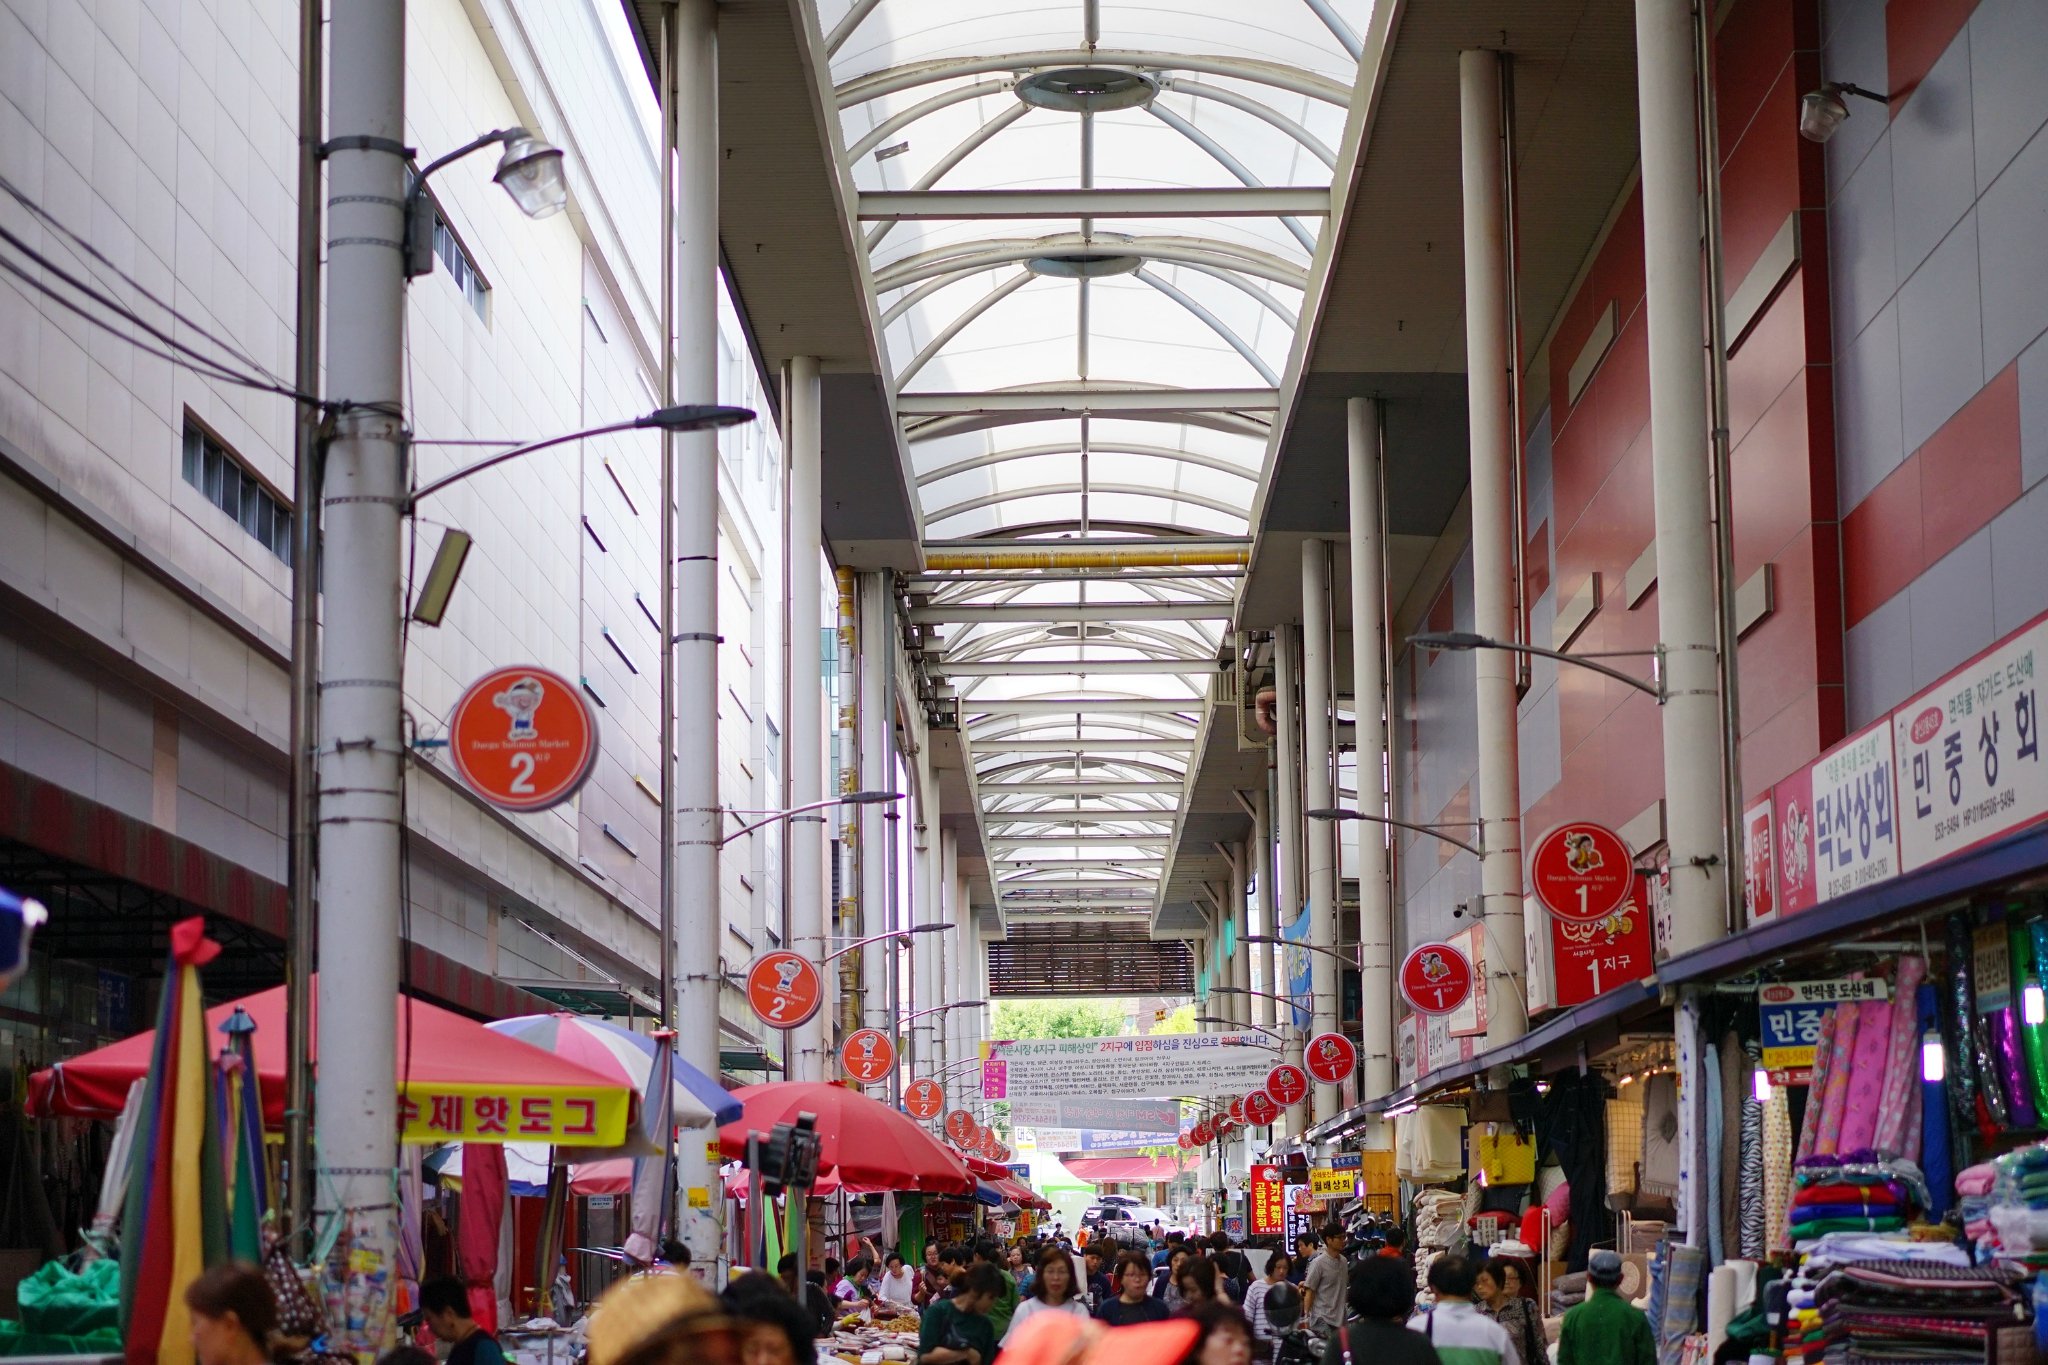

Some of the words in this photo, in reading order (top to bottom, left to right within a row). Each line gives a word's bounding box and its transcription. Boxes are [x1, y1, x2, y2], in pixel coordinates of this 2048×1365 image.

[1912, 688, 2039, 819] 민중상회
[510, 752, 536, 793] 2
[1816, 761, 1893, 872] 덕산상회
[1575, 885, 1588, 914] 1
[1586, 958, 1601, 995] 1
[1603, 954, 1631, 970] 지구
[1433, 988, 1444, 1009] 1
[1801, 983, 1837, 1000] 면직물
[1839, 981, 1875, 997] 도산매
[768, 996, 786, 1020] 2
[1033, 1043, 1057, 1055] 4지구
[1100, 1040, 1133, 1053] 2지구에
[1134, 1038, 1180, 1052] 입점하심을
[1182, 1036, 1219, 1050] 진심으로
[861, 1061, 872, 1078] 2
[1329, 1064, 1337, 1079] 1
[1283, 1090, 1290, 1103] 1
[920, 1103, 928, 1116] 2
[1259, 1112, 1265, 1124] 1
[958, 1128, 965, 1138] 2
[963, 1138, 970, 1147] 2
[980, 1141, 986, 1149] 2
[1314, 1179, 1351, 1192] 월배상회
[1255, 1182, 1268, 1227] 고급전문점
